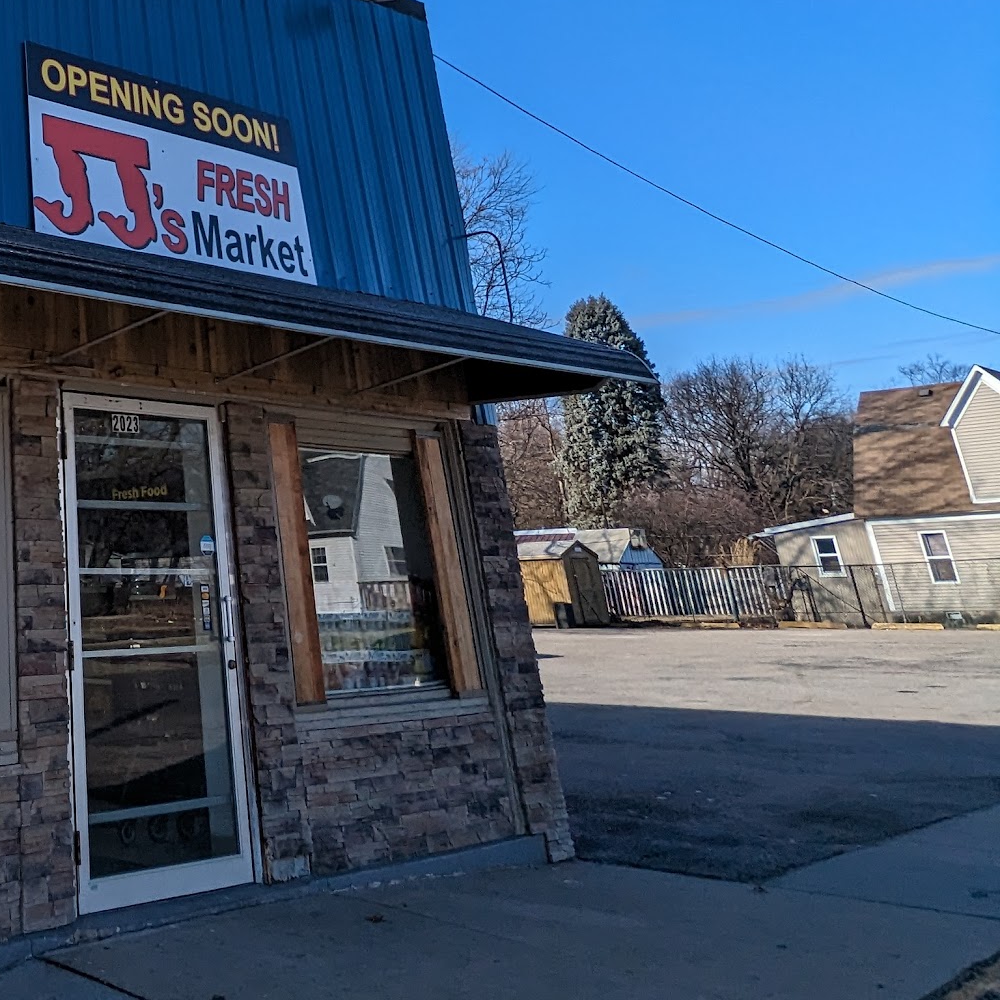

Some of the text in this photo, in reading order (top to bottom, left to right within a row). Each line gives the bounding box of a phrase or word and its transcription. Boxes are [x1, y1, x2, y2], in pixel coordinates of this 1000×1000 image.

[41, 58, 280, 153] OPENING SOON!
[33, 113, 309, 277] JJ's Market
[196, 159, 291, 222] FRESH
[112, 415, 139, 432] 2023
[111, 484, 168, 500] Fresh Food
